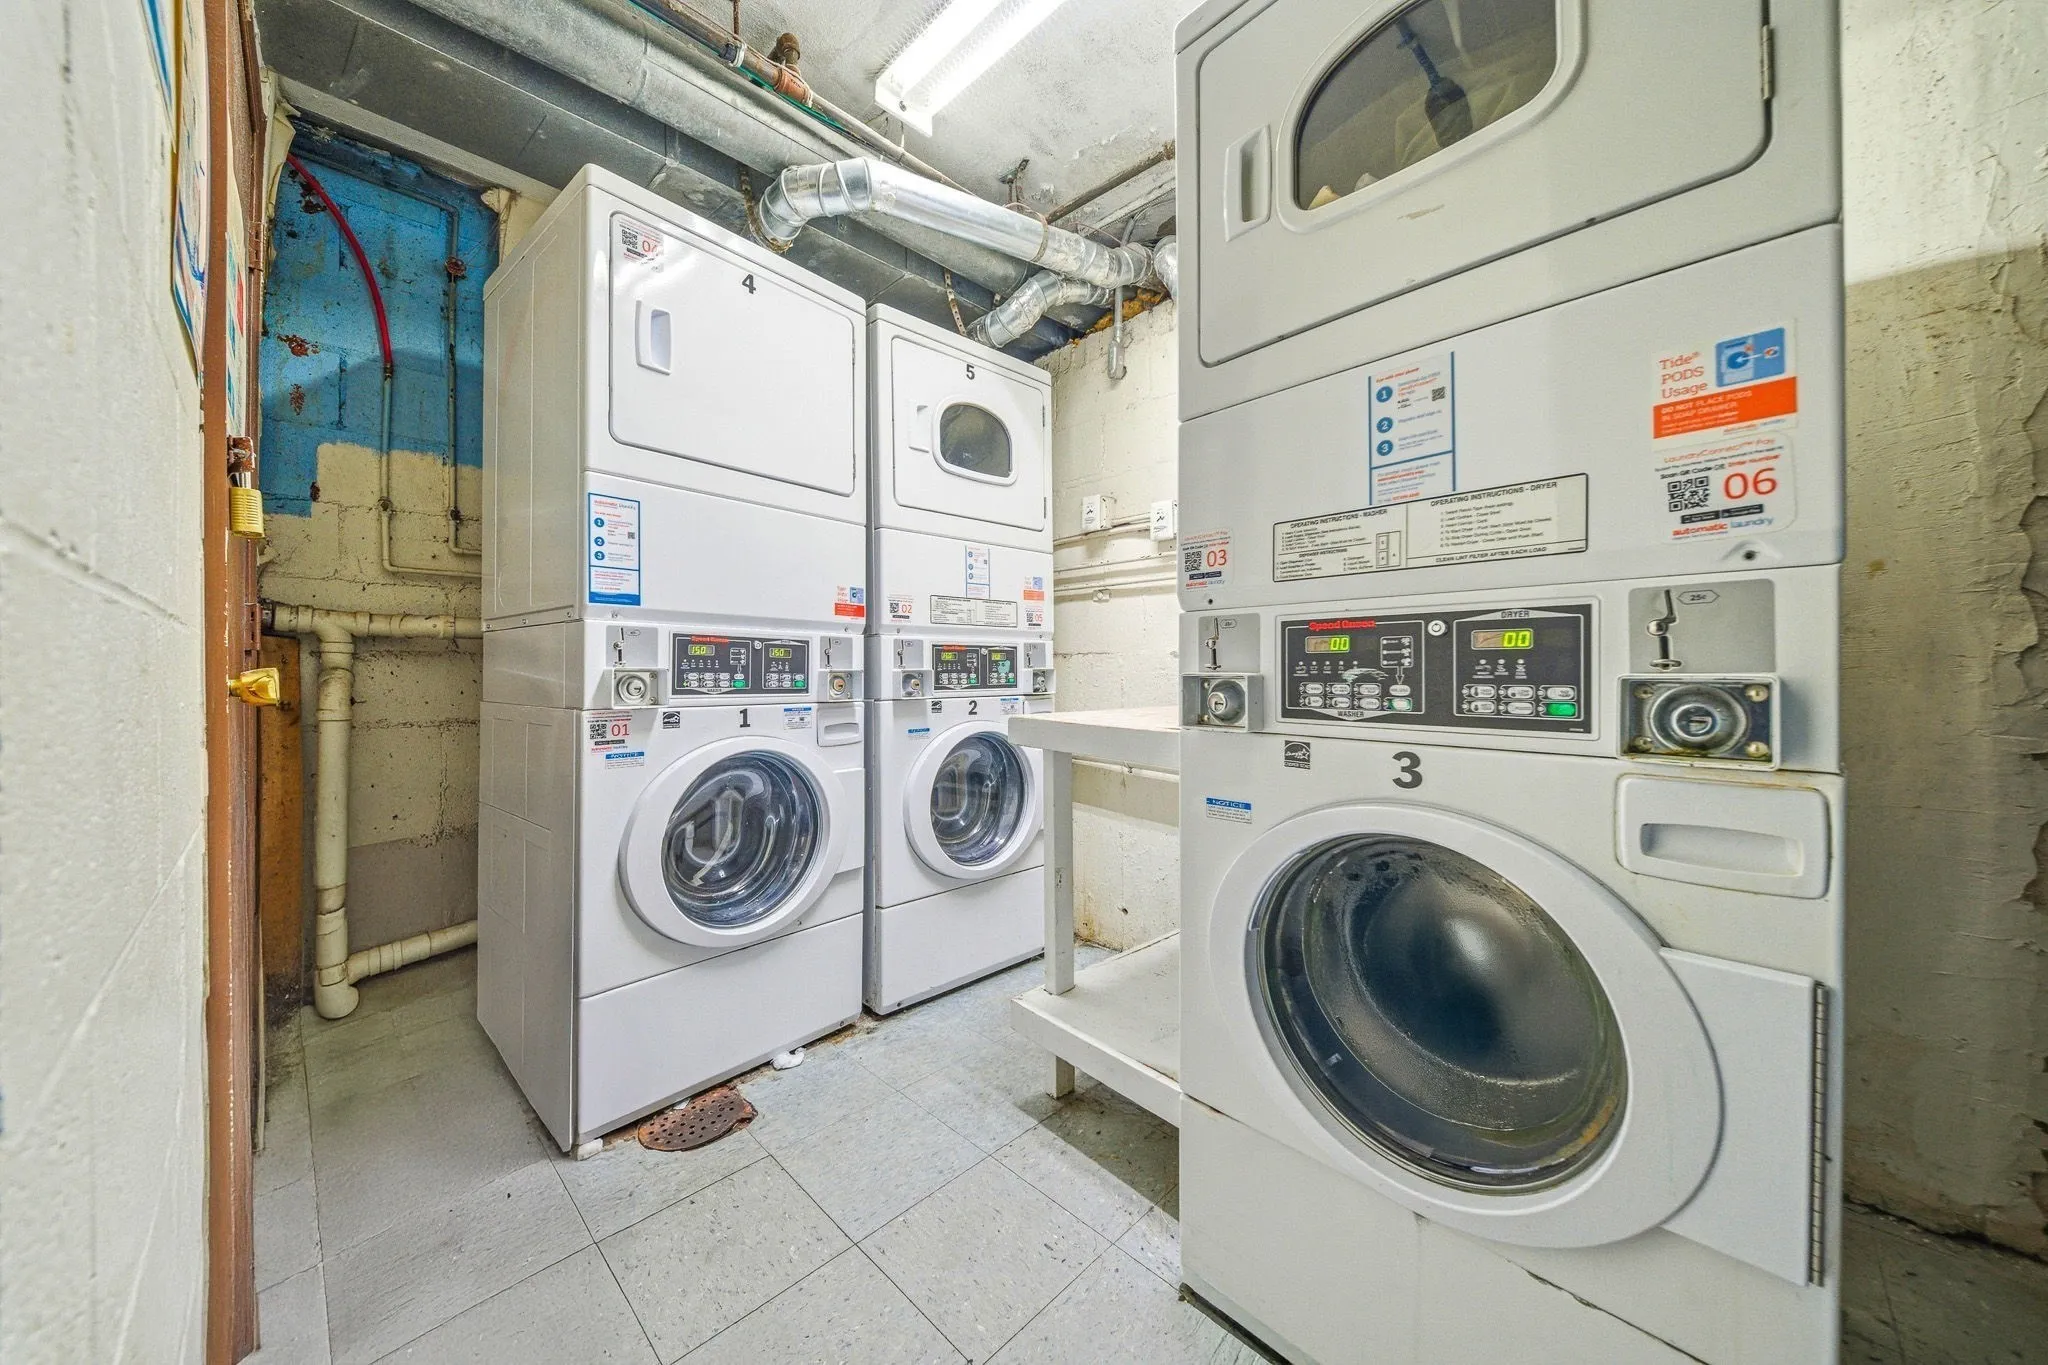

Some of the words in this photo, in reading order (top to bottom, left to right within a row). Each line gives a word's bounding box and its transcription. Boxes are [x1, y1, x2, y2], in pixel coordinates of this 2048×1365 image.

[742, 274, 756, 294] 4
[966, 364, 975, 380] 5
[1661, 366, 1705, 385] PODS
[1382, 390, 1387, 400] 1
[1662, 382, 1708, 399] Usage
[1381, 421, 1388, 430] 2
[1382, 443, 1388, 453] 3
[1724, 467, 1777, 500] 06
[1430, 495, 1469, 507] OPERATING
[1471, 486, 1524, 500] INSTRUCTIONS
[1530, 481, 1557, 491] DRYER
[1290, 519, 1319, 529] OPERATING
[1320, 514, 1358, 524] INSTRUCTIONS
[1672, 523, 1728, 536] automatic
[1730, 517, 1774, 528] laundry
[1207, 549, 1227, 567] 03
[1469, 552, 1489, 560] FILTER
[1489, 550, 1510, 558] AFTER
[1529, 546, 1547, 554] LOAD
[901, 604, 913, 614] 02
[1501, 610, 1530, 619] DRYER
[1308, 620, 1341, 631] Speed
[1341, 619, 1377, 629] Queen
[1331, 637, 1349, 651] 00
[1503, 631, 1531, 648] 00
[968, 700, 978, 715] 2
[1337, 710, 1364, 718] WASHER
[740, 708, 751, 728] 1
[611, 724, 630, 737] 01
[1392, 751, 1423, 789] 3
[1212, 799, 1245, 809] NOTICE
